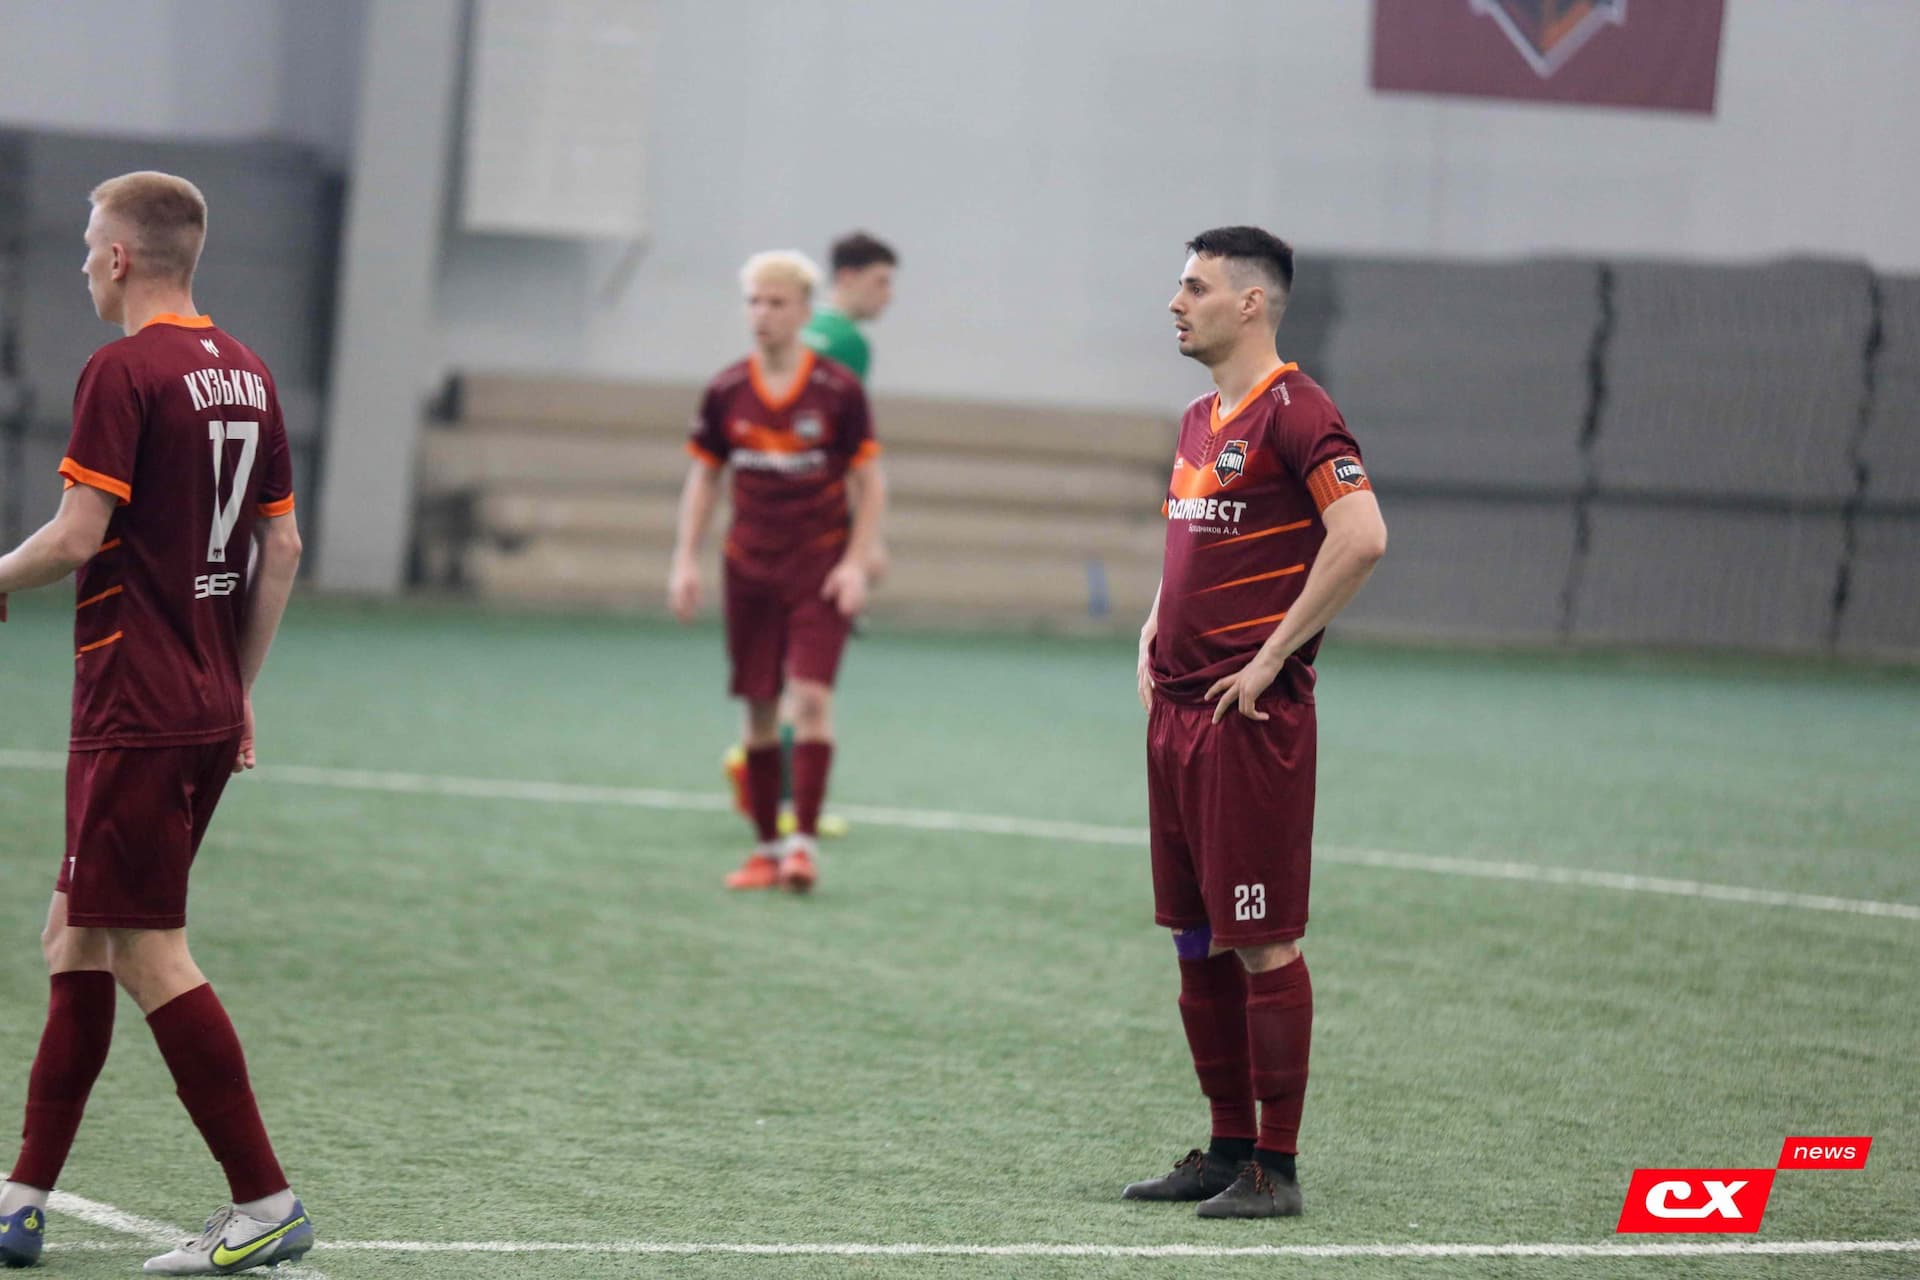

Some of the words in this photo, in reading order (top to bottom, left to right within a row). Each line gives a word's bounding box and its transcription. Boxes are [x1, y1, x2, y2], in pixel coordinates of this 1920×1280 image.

[183, 368, 267, 412] КУЗЬКИН
[1218, 452, 1243, 471] ТЕМП
[207, 420, 259, 562] 17
[1234, 883, 1266, 921] 23
